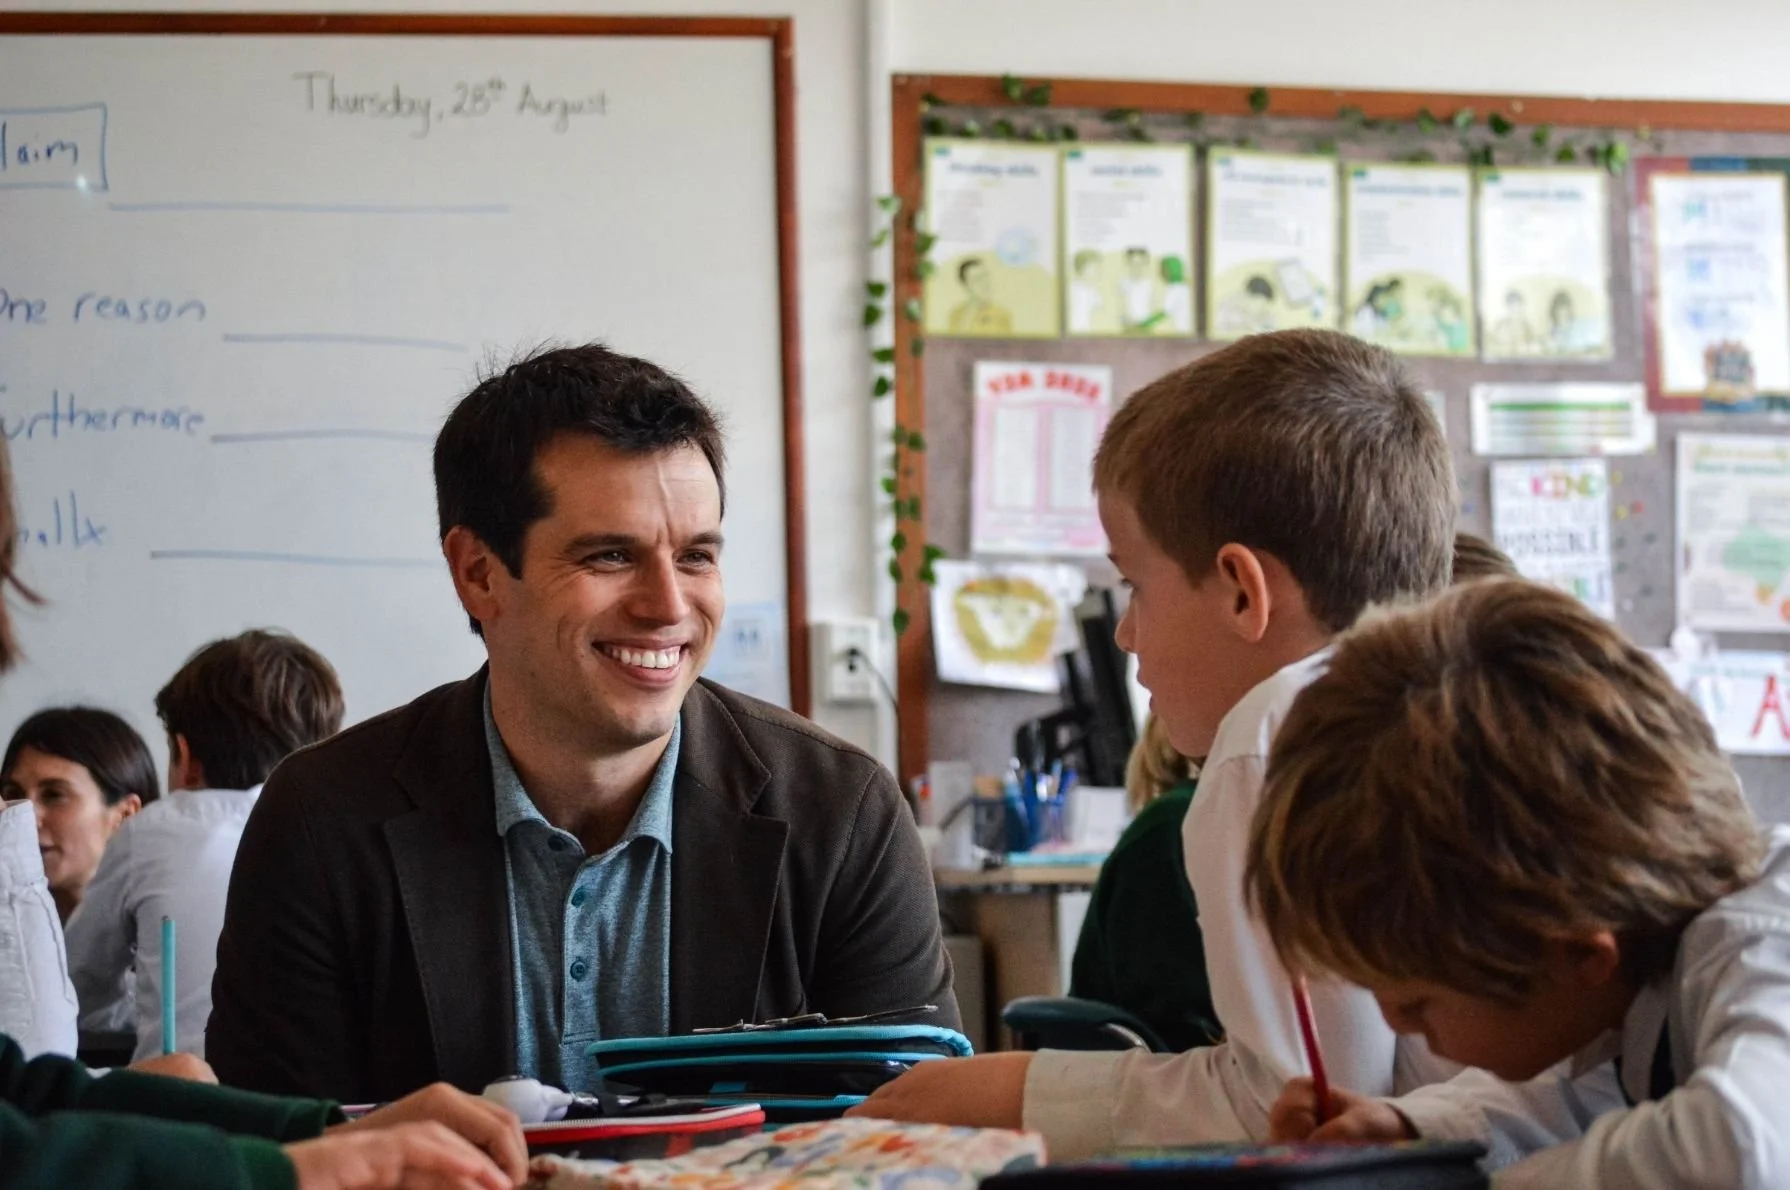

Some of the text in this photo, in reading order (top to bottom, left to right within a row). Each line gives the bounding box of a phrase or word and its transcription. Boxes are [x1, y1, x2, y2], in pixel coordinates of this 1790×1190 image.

[292, 71, 444, 139] Thursday,
[516, 80, 608, 134] August
[0, 120, 79, 172] laim
[73, 291, 206, 323] reason
[0, 388, 205, 440] urthermore
